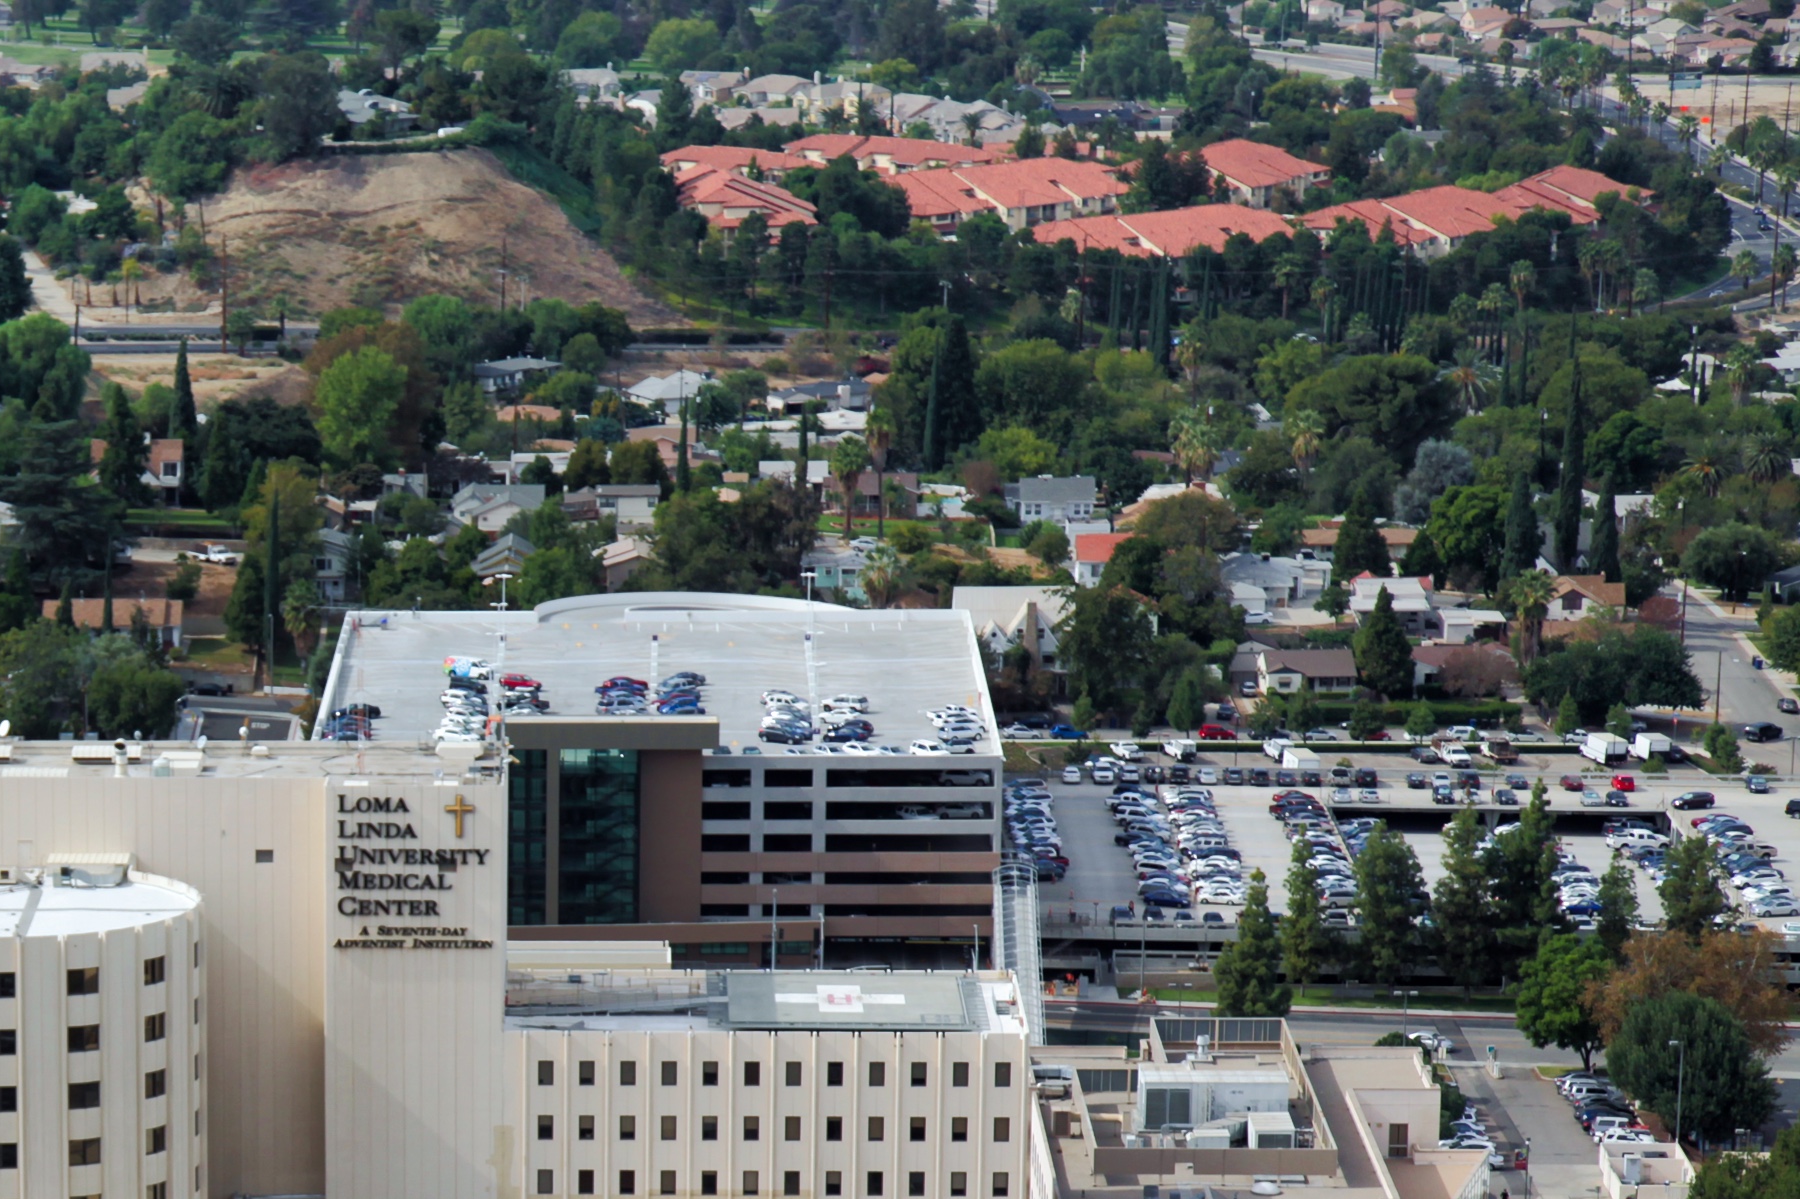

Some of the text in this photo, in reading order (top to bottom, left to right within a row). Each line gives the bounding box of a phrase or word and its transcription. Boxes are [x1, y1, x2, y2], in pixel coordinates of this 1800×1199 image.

[337, 794, 409, 813] LOMA
[337, 820, 418, 839] LINDA
[338, 846, 490, 865] UNIVERSITY
[338, 871, 453, 890] MEDICAL
[338, 896, 440, 916] CENTER
[359, 925, 467, 936] A SEVENTH-DAY
[334, 938, 493, 949] ADVENTIST INSTITUTION
